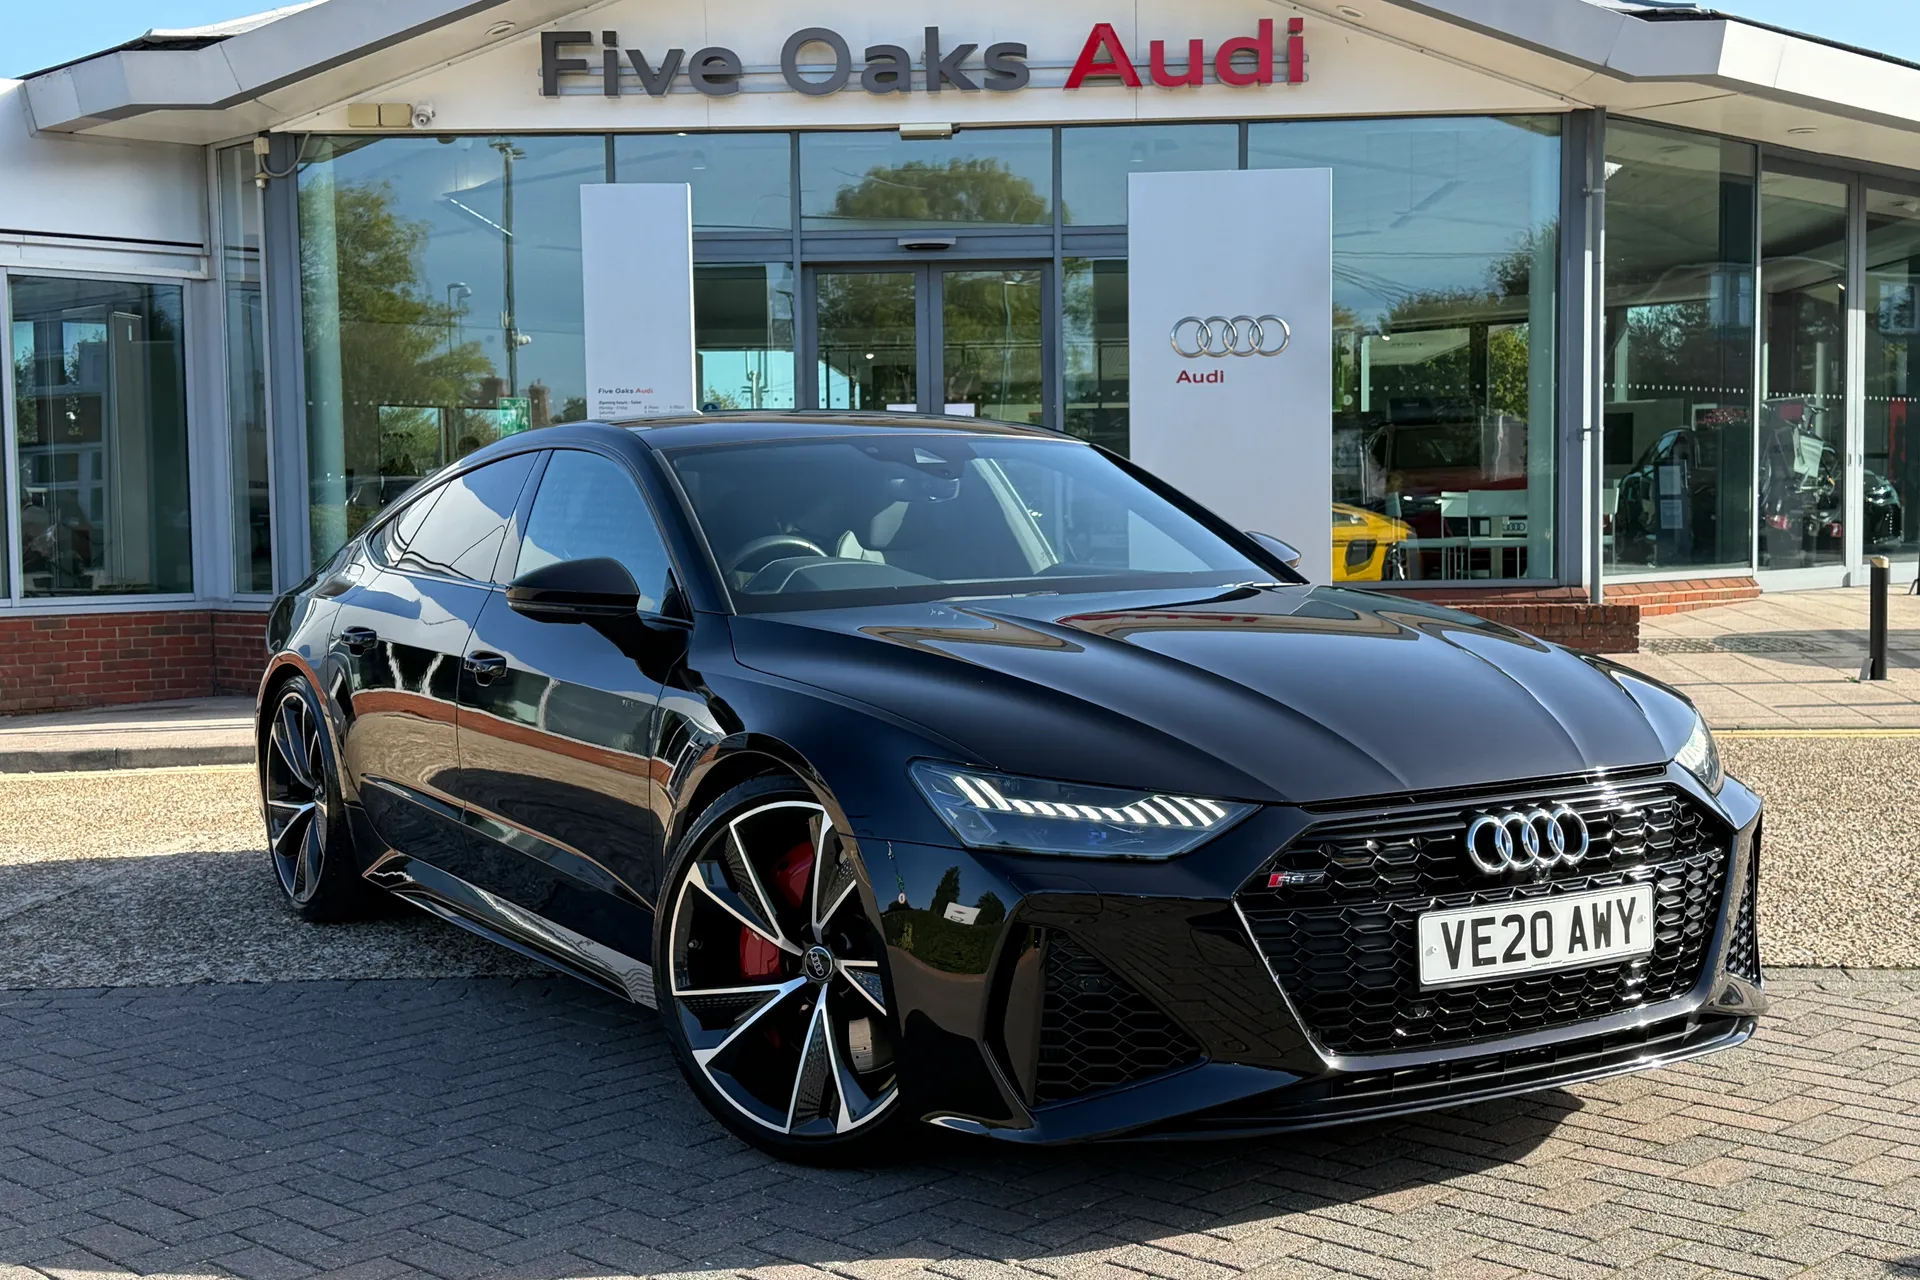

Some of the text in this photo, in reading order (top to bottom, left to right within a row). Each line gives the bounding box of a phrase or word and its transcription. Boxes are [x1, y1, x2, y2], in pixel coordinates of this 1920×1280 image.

[541, 17, 1304, 98] Five Oaks Audi
[1176, 369, 1225, 384] Audi
[1440, 896, 1636, 970] VE20 AWY
